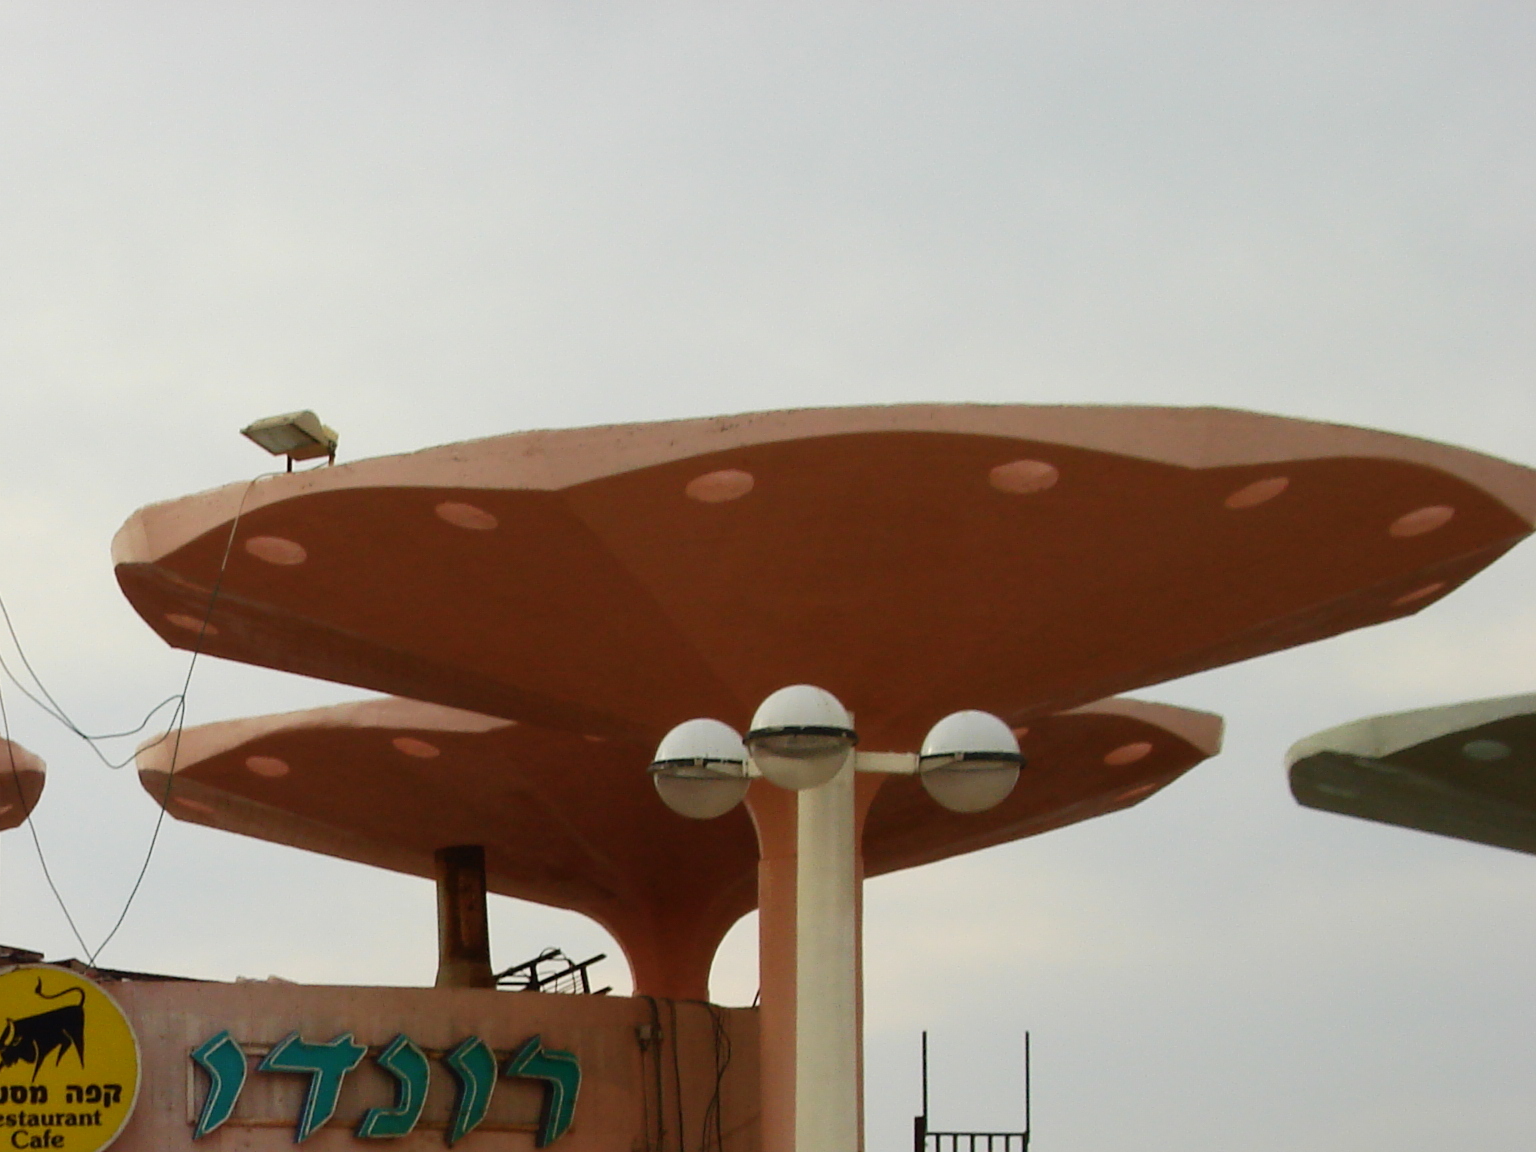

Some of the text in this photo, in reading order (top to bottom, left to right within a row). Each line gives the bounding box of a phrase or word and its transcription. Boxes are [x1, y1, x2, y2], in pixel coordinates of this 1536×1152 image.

[65, 1083, 123, 1108] קפה
[191, 1029, 582, 1149] רונדו
[10, 1129, 65, 1149] Cafe
